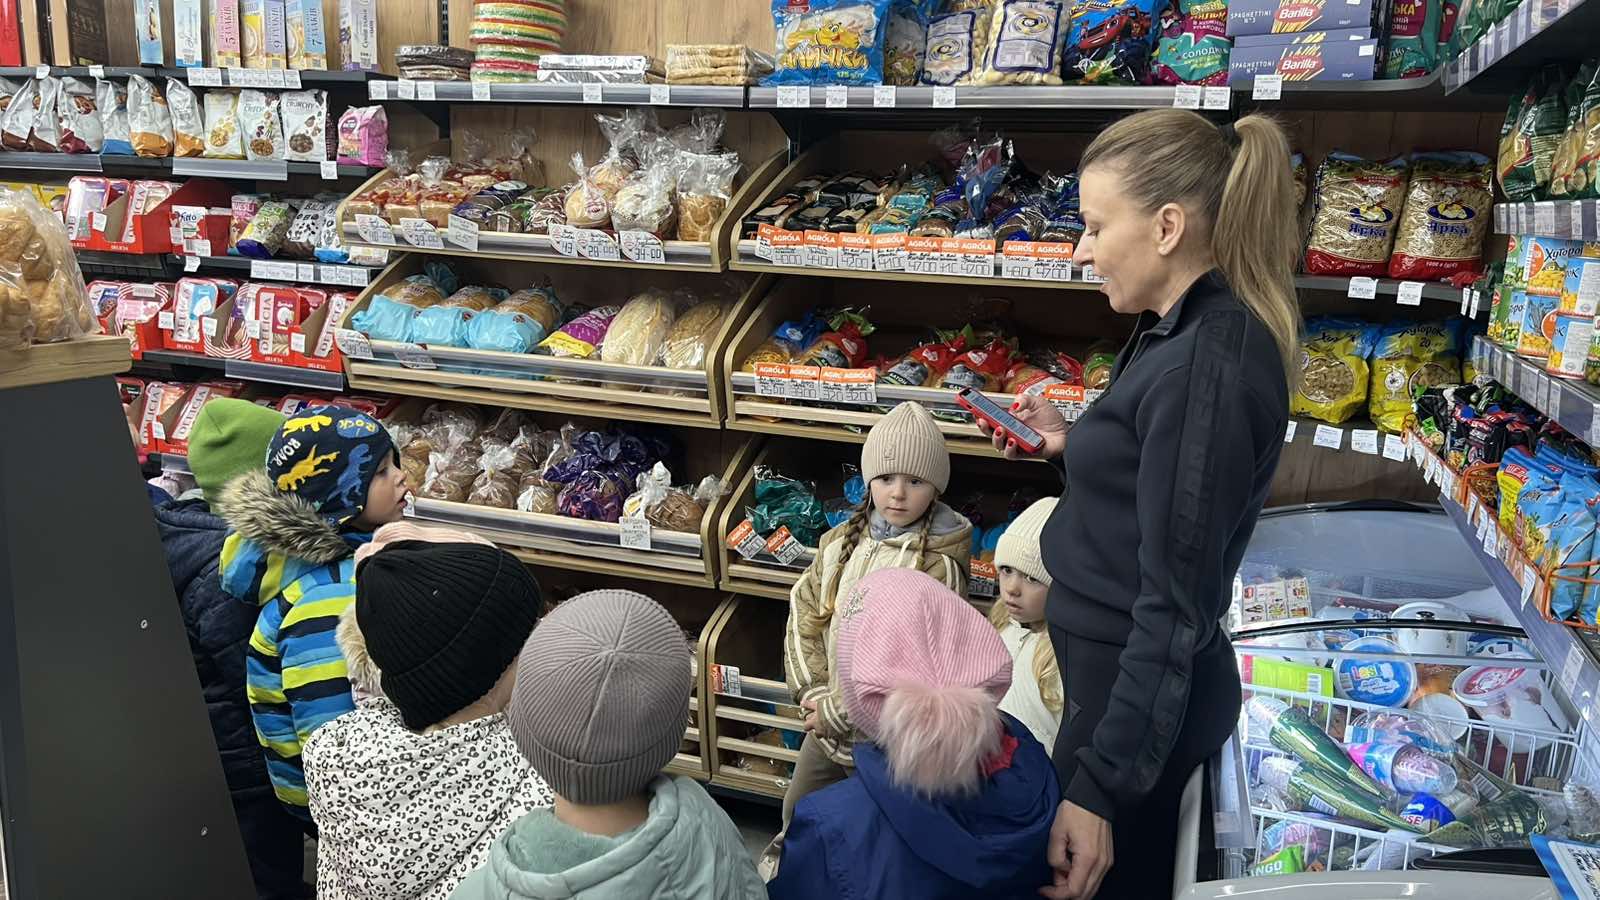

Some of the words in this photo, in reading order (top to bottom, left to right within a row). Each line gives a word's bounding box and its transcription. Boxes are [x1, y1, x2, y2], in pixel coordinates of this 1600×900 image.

[1279, 7, 1313, 19] Barilla
[1281, 58, 1317, 70] Barilla
[1349, 223, 1387, 238] Ярка
[1428, 221, 1468, 236] Ярка
[773, 232, 801, 242] AGRÓLA
[807, 232, 836, 244] AGRÓLA
[908, 239, 938, 248] AGRÓLA
[962, 239, 992, 250] AGRÓLA
[1037, 244, 1070, 254] AGRÓLA
[261, 299, 272, 350] DELICIA
[1049, 387, 1081, 397] AGRÓLA
[339, 419, 377, 433] ROCK
[272, 437, 302, 467] ROAR
